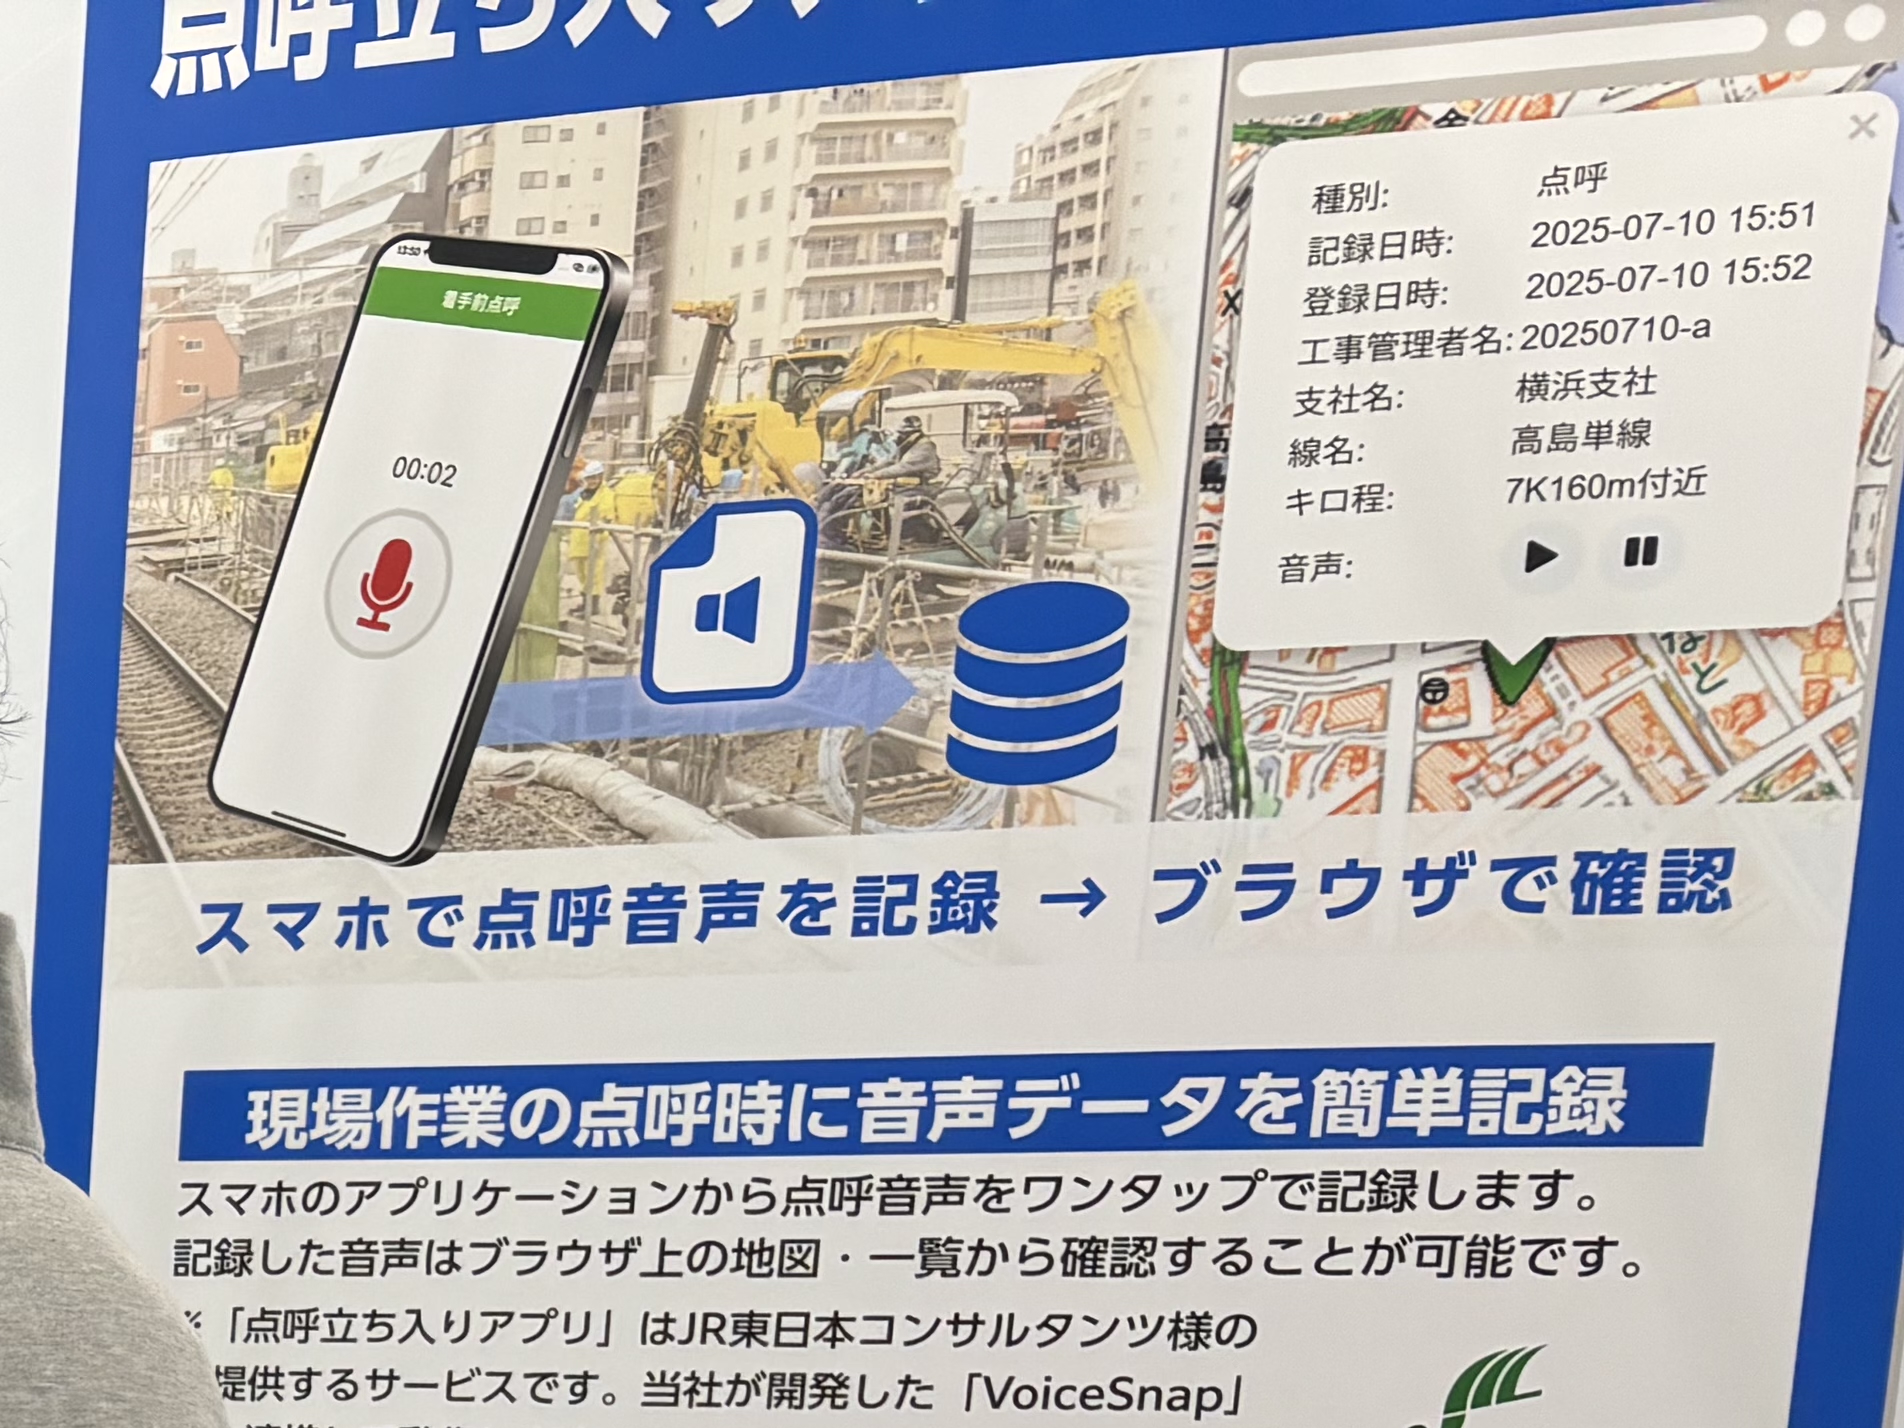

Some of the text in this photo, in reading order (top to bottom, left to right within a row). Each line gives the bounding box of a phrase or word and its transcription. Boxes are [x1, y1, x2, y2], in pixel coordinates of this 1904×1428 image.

[1311, 161, 1608, 216] 種別: 点呼
[1306, 201, 1816, 268] 記録日時: 2025-07-10 15:51
[1302, 253, 1813, 319] 登録日時: 2025-07-10 15:52
[1297, 314, 1712, 368] 工事管理者名: 20250710-a
[1293, 364, 1658, 418] 支社名: 横浜支社
[1288, 417, 1652, 470] 線名: 高島単線
[392, 456, 458, 489] 00:02
[1284, 464, 1709, 518] キロ程: 7K160m付近
[1277, 550, 1354, 585] 音声:
[196, 845, 1736, 960] スマホで点呼音声を記録 ブラウザで確認
[246, 1065, 1627, 1151] 現場作業の点呼時に音声データを簡単記録
[176, 1167, 1600, 1219] スマホのアプリケーションから点呼音声をワンタップで記録します。
[172, 1234, 1643, 1281] 記録した音声はブラウザ上の地図・一覧から確認することが可能です。
